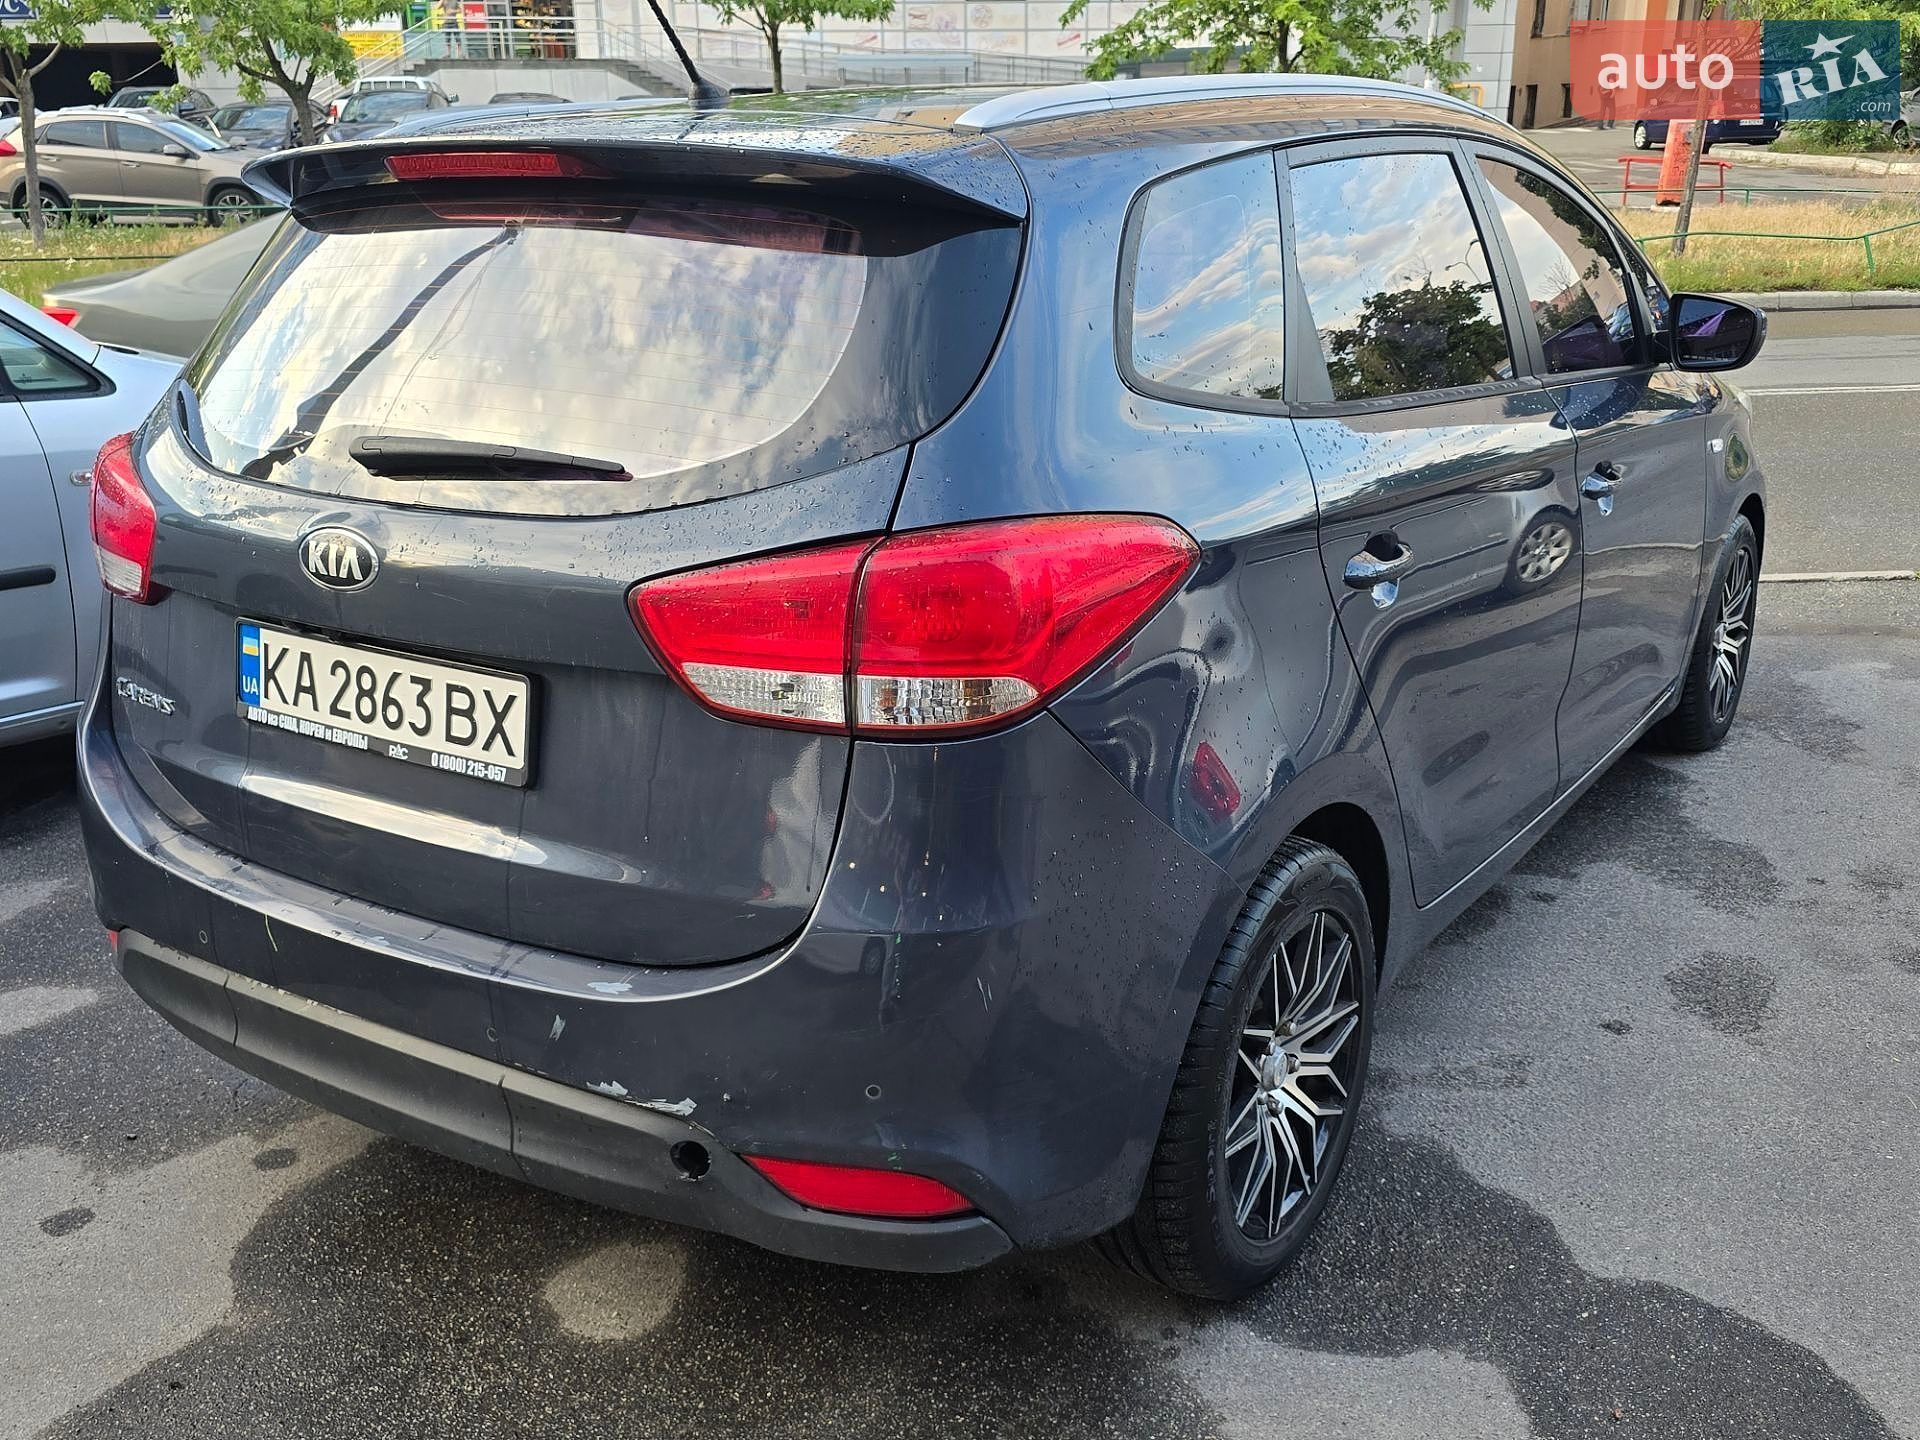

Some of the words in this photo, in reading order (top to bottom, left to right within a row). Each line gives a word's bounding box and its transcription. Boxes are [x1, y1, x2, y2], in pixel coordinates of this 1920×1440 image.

[308, 540, 364, 581] KIA
[242, 675, 260, 695] UA
[247, 706, 268, 723] АВТО
[268, 713, 279, 727] из
[332, 728, 369, 750] ЕВРОПЫ
[440, 755, 466, 773] (800)
[467, 761, 507, 782] 215-057
